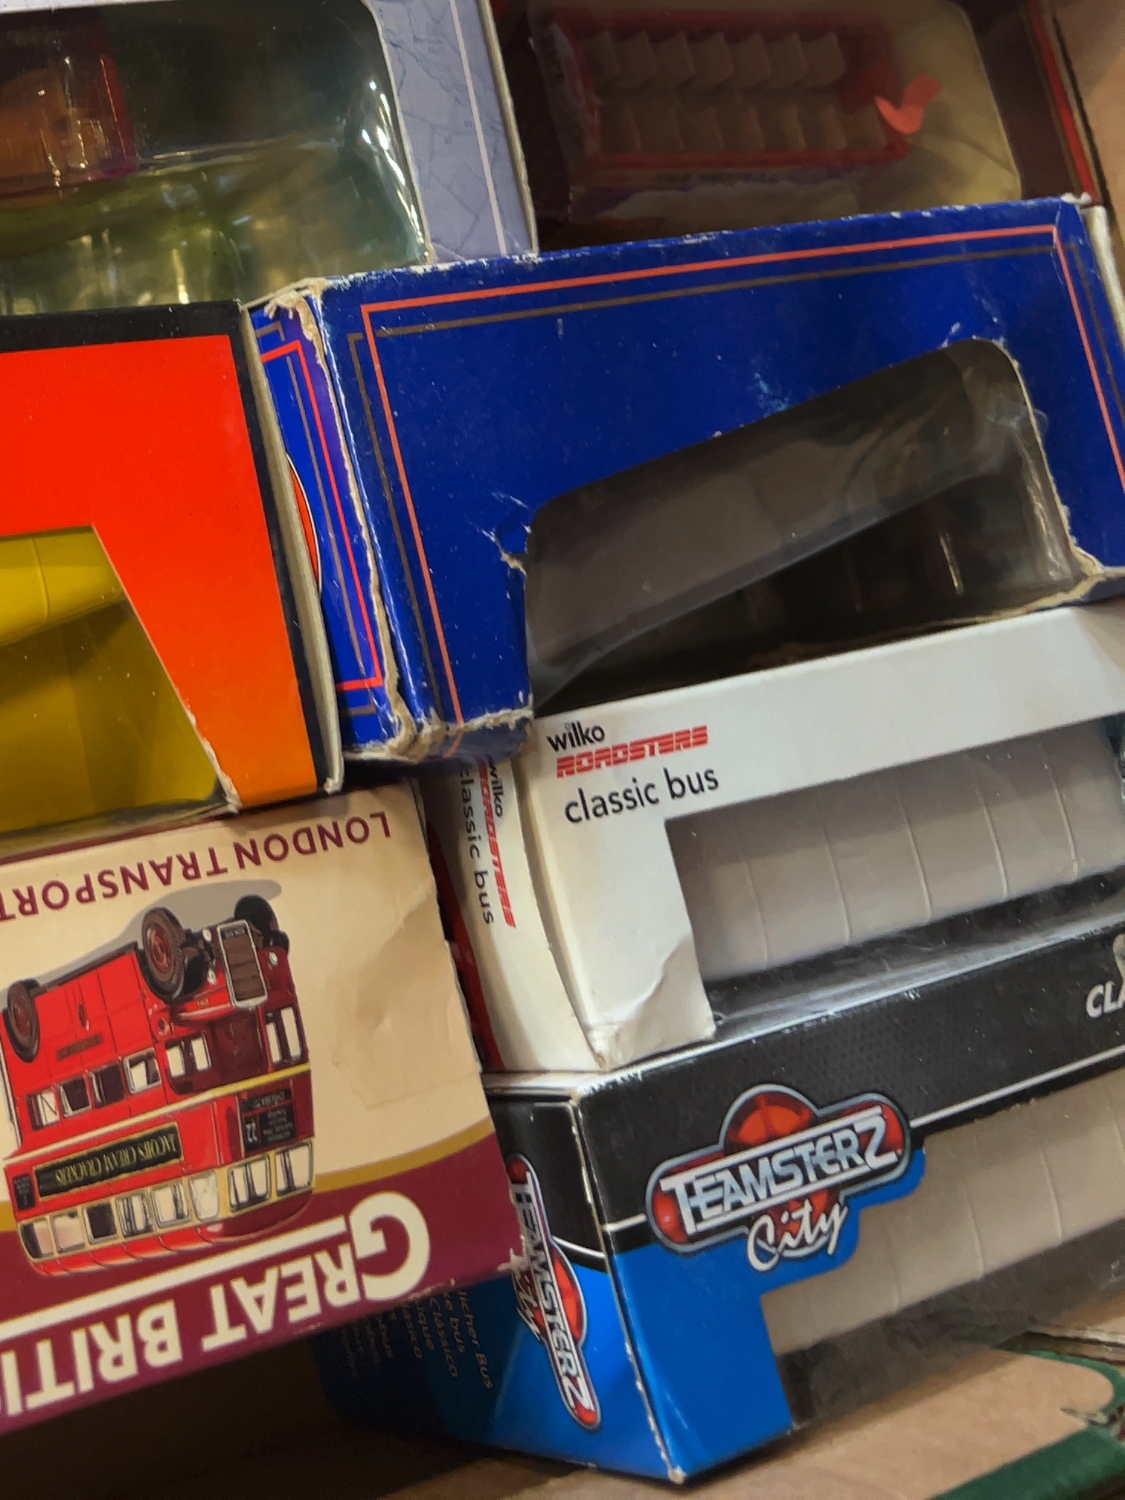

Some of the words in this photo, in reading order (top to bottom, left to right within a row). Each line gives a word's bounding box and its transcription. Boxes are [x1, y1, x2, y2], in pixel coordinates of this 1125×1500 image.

[546, 720, 606, 753] wilko
[556, 725, 709, 779] ROADSTERS
[486, 754, 505, 819] wilko
[563, 777, 661, 825] classic
[663, 766, 720, 800] bus
[233, 811, 392, 870] LONDON
[477, 756, 517, 930] ROADSTERS
[474, 870, 495, 925] bus
[54, 1158, 103, 1187] CRACKERS
[102, 1146, 137, 1173] CREAM
[660, 1106, 903, 1236] TEAMSTERZ
[747, 1200, 849, 1272] City
[202, 1191, 432, 1354] GREAT
[510, 1170, 596, 1412] TEAMSTERZ
[449, 1316, 467, 1354] bus
[475, 1352, 494, 1390] Bus
